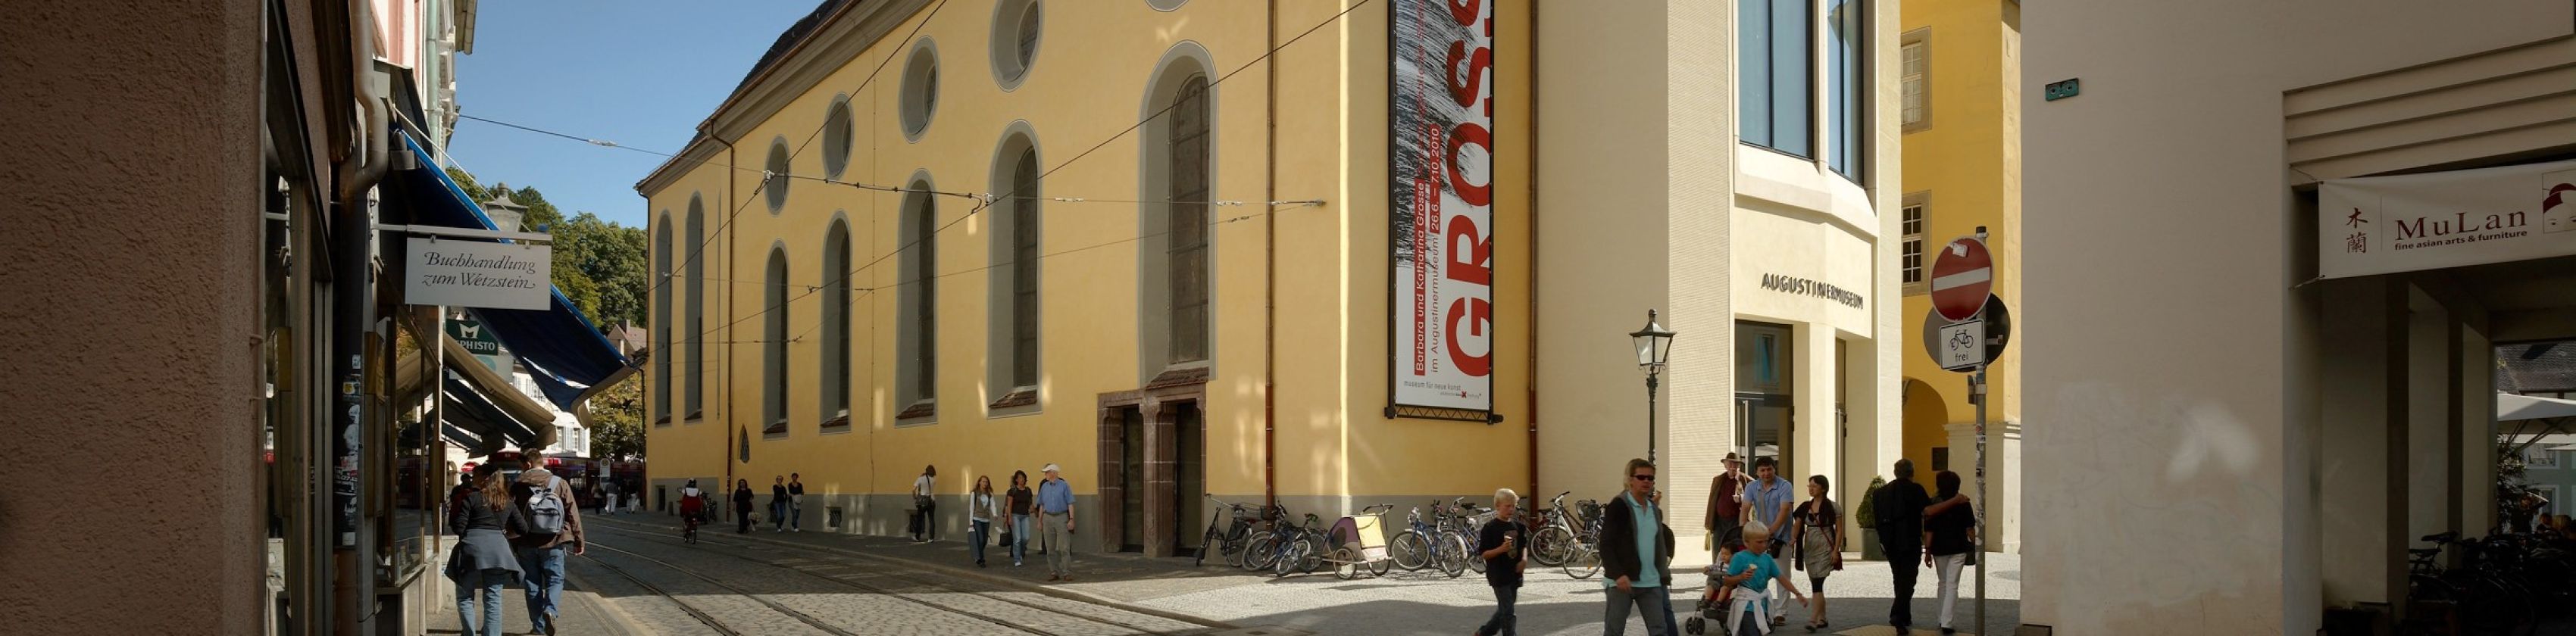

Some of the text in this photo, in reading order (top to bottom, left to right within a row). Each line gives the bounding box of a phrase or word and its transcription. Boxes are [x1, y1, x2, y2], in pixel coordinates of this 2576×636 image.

[1416, 182, 1425, 227] Grosse
[1430, 201, 1440, 231] 26.6.
[2346, 207, 2368, 254] 木蘭
[2394, 242, 2414, 251] fine
[2416, 239, 2443, 248] asian
[2446, 236, 2465, 245] arts
[2478, 230, 2528, 241] furniture
[2395, 210, 2528, 241] MuLan
[424, 251, 536, 274] Buchhandlung
[1416, 230, 1425, 291] Katharina
[422, 272, 536, 288] zum Wetzstein
[1761, 272, 1864, 310] AUGUSTINERMUSEUM
[1416, 294, 1425, 317] und
[1430, 237, 1440, 354] Augustinermuseum
[1416, 321, 1425, 371] Barbara
[1955, 351, 1969, 362] frei
[1430, 358, 1439, 374] im
